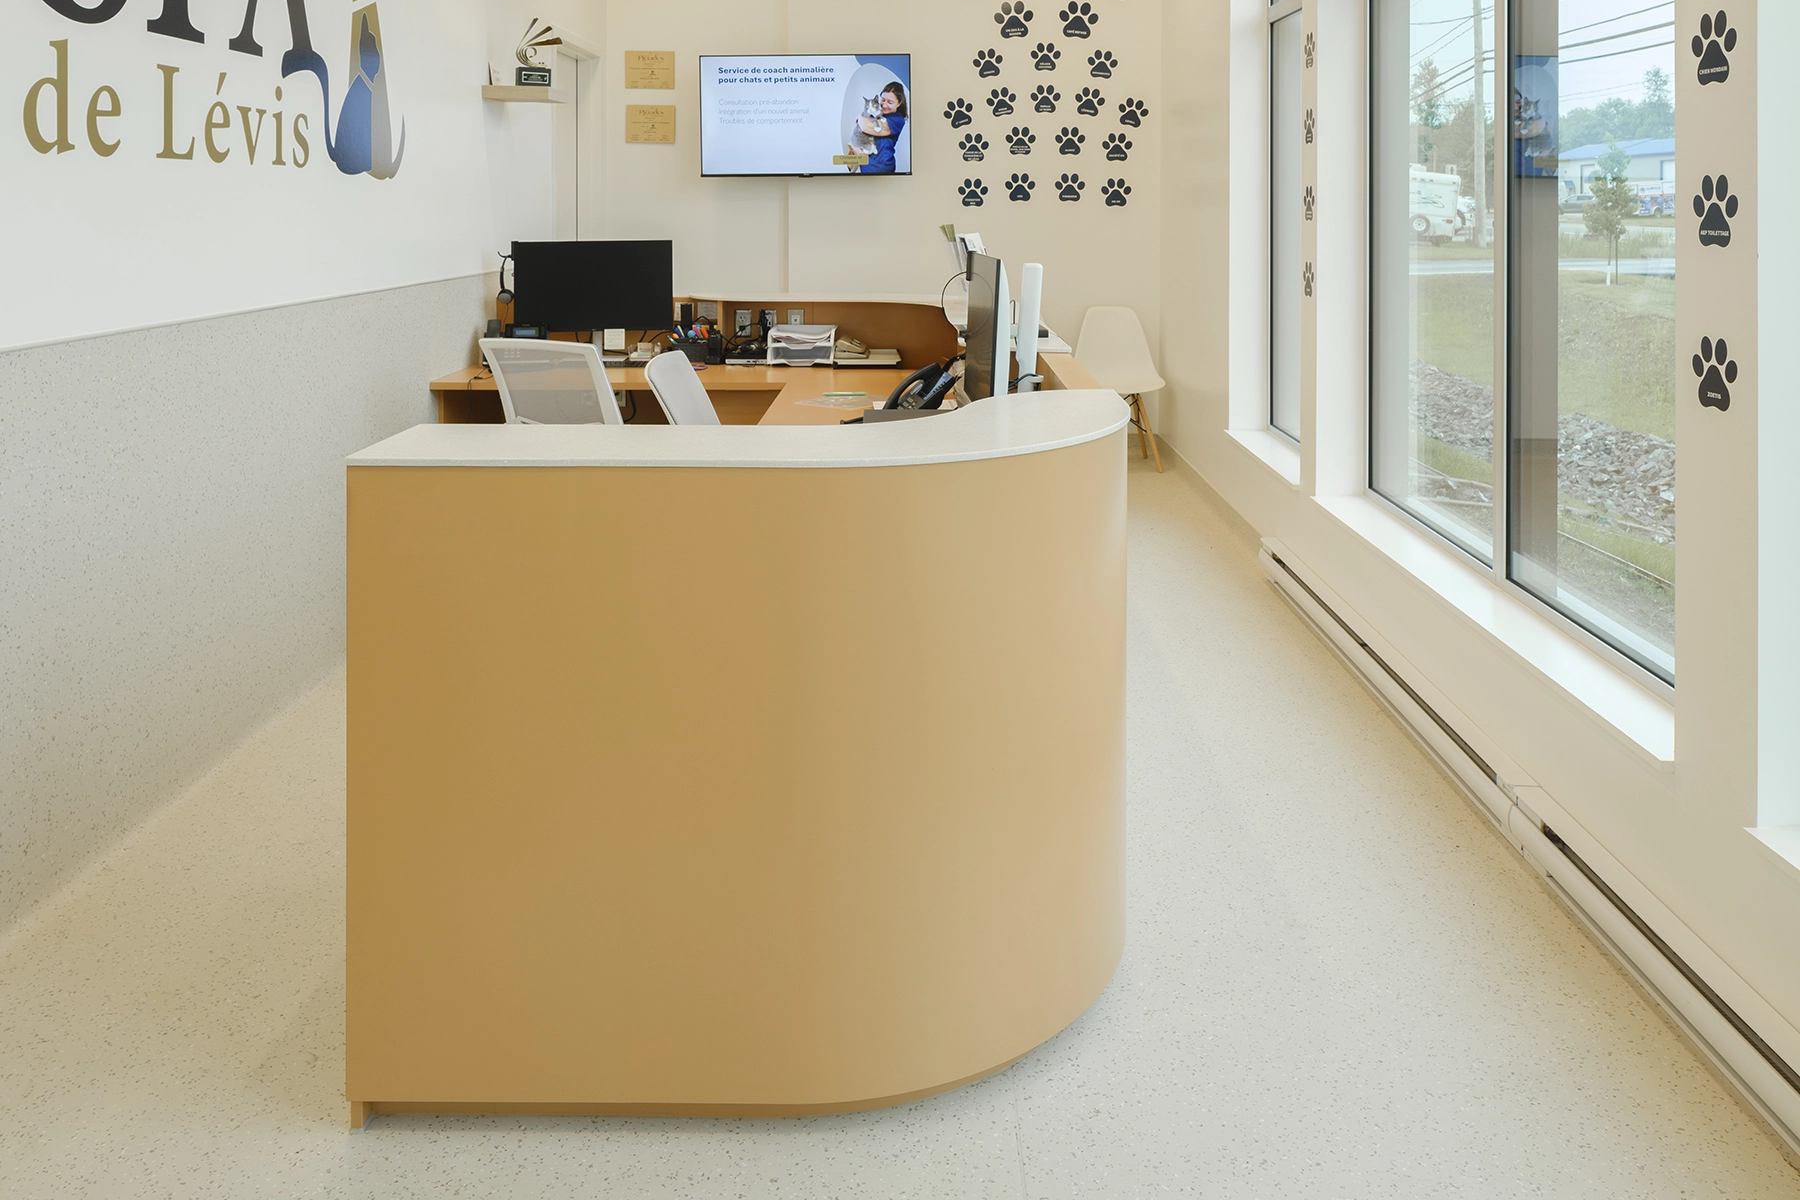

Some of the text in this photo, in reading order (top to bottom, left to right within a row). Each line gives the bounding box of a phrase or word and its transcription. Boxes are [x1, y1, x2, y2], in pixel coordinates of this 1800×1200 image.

[751, 66, 761, 74] de
[762, 66, 788, 74] coach
[774, 75, 798, 84] petits
[22, 38, 310, 169] de Lévis
[759, 98, 798, 107] pré-abandon
[718, 108, 752, 116] Intégration
[756, 117, 803, 125] comportement
